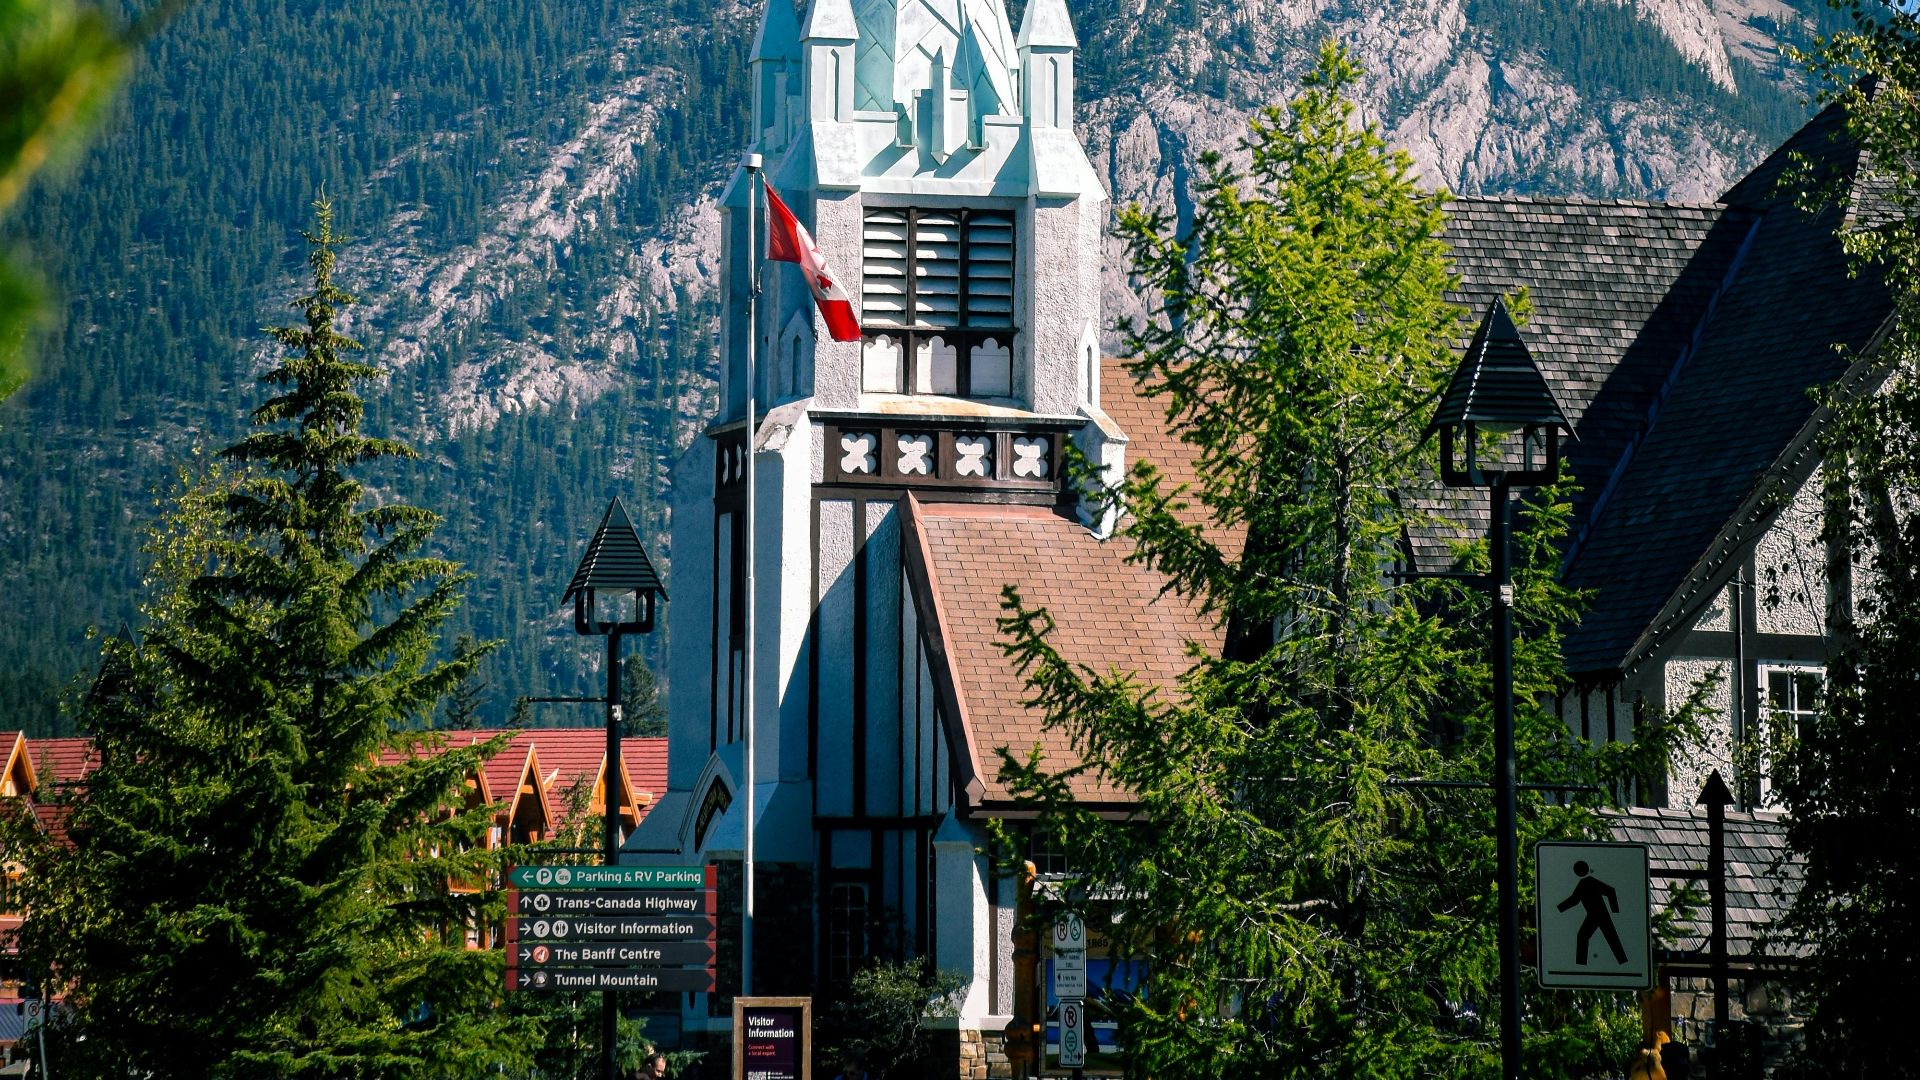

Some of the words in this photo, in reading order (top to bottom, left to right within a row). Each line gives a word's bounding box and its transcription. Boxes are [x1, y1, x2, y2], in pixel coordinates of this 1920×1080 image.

[576, 871, 622, 884] Parking
[624, 872, 632, 882] &
[635, 871, 653, 882] RV
[656, 871, 701, 884] Parking
[555, 897, 641, 909] Trans-Canada
[645, 897, 698, 911] Highway
[574, 922, 616, 934] Visitor
[620, 922, 694, 934] Information
[555, 948, 578, 960] The
[582, 948, 616, 960] Banff
[619, 948, 661, 960] Centre
[555, 974, 596, 986] Tunnel
[600, 974, 658, 986] Mountain
[748, 1016, 775, 1026] Visitor
[748, 1028, 794, 1038] Information
